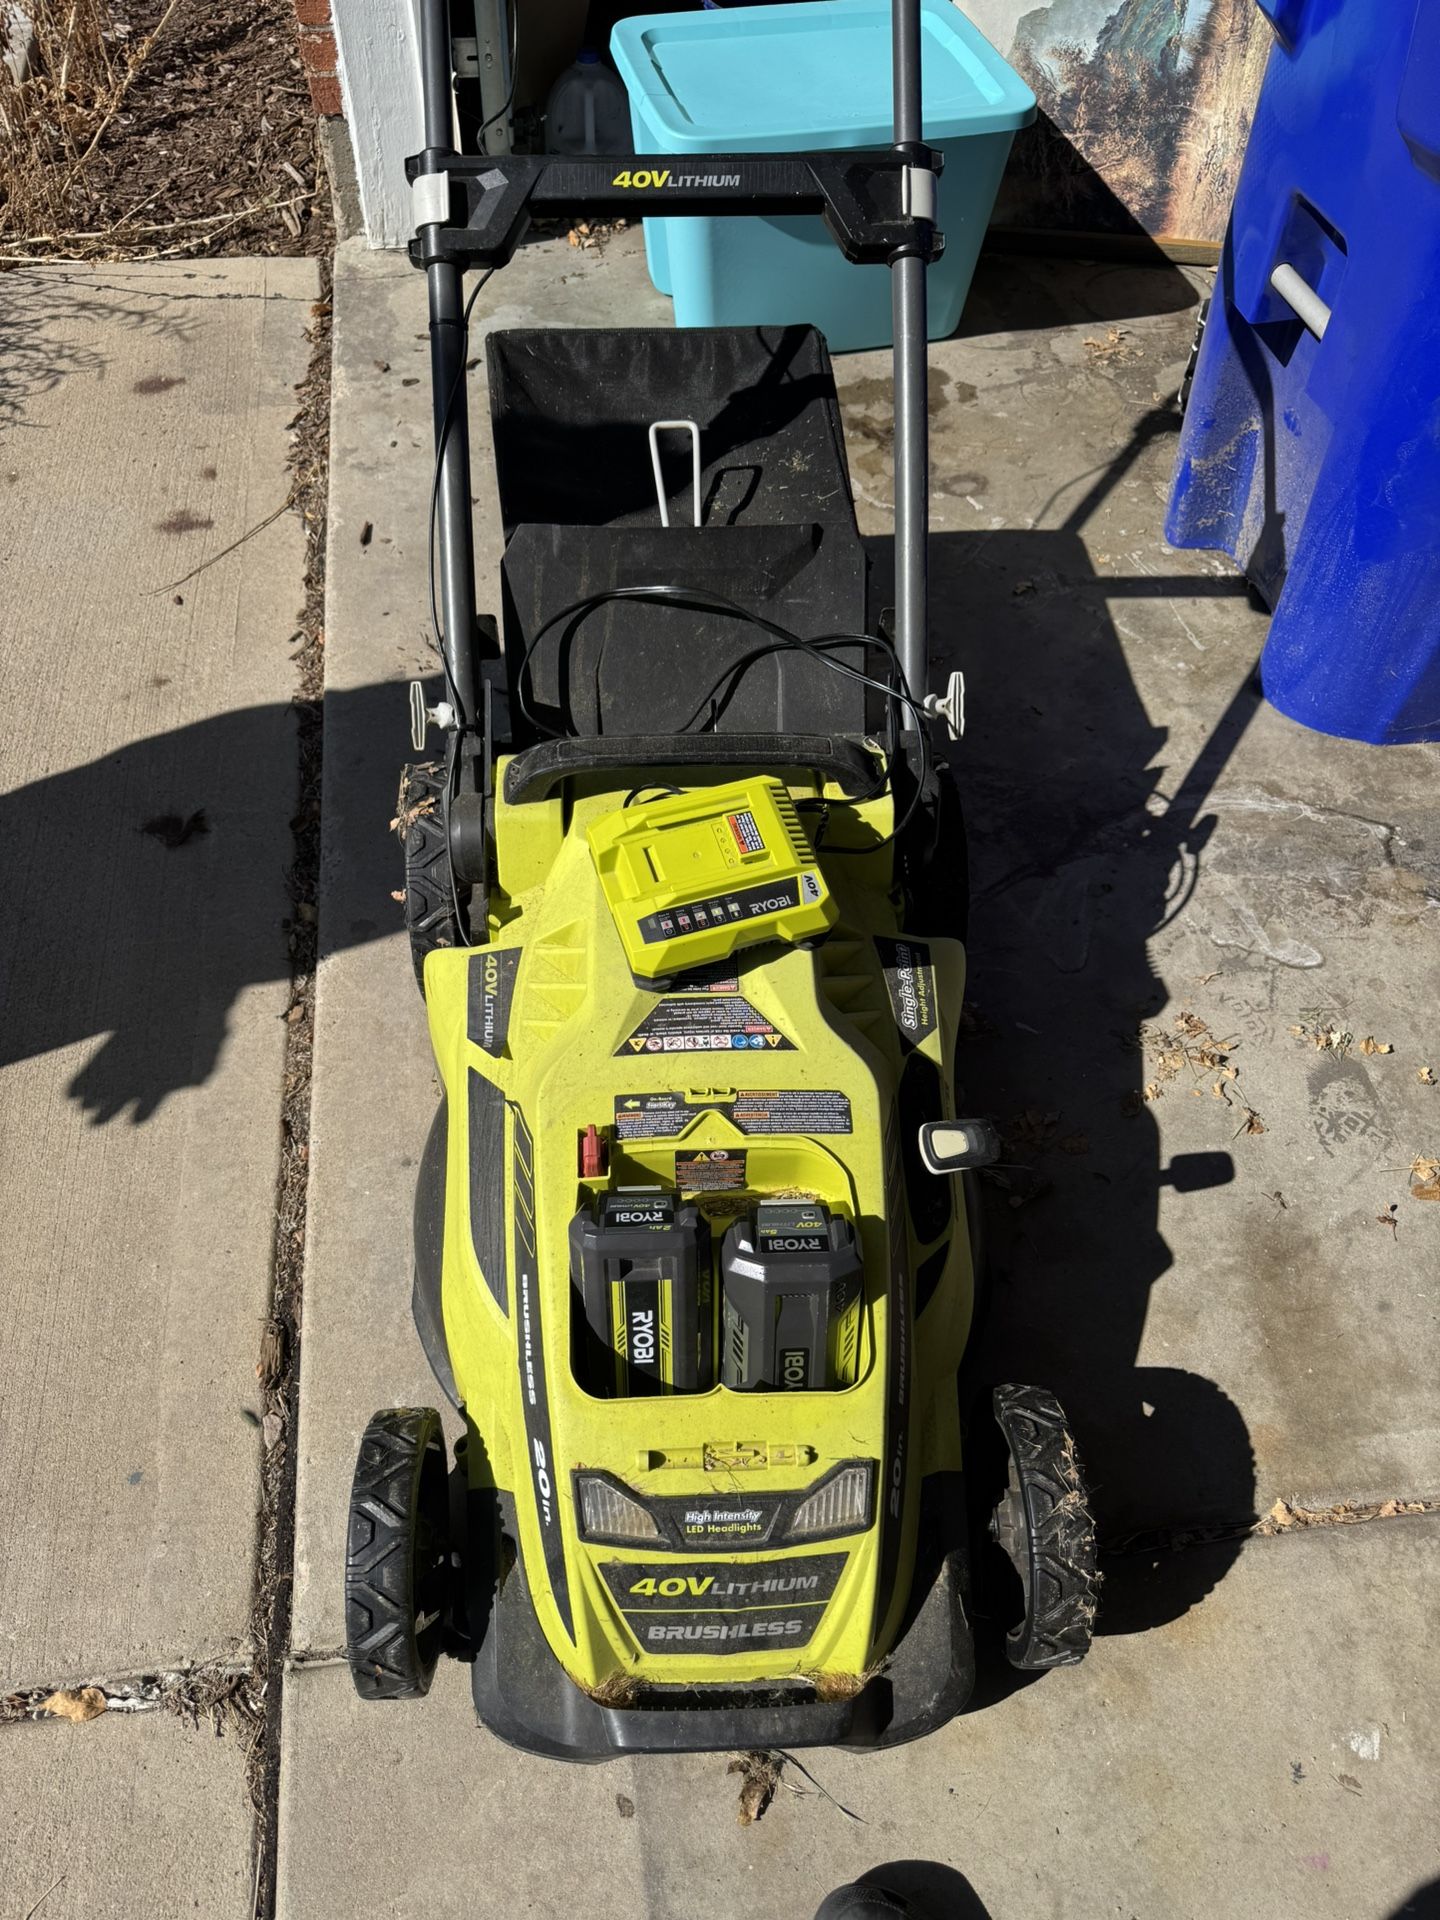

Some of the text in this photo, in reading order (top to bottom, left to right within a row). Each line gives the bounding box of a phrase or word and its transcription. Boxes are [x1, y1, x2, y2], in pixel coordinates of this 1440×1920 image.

[804, 874, 820, 897] 40V
[749, 895, 793, 915] RYOBI
[920, 998, 928, 1026] Height
[616, 1211, 664, 1223] RYOBI
[768, 1238, 822, 1250] RYOBI
[522, 1274, 537, 1405] BRUSHLESS
[632, 1310, 655, 1364] RYOBI
[784, 1351, 804, 1391] YOBI
[685, 1508, 763, 1525] High Intensity
[686, 1523, 762, 1534] LED Headlights
[648, 1620, 803, 1641] BRUSHLESS
